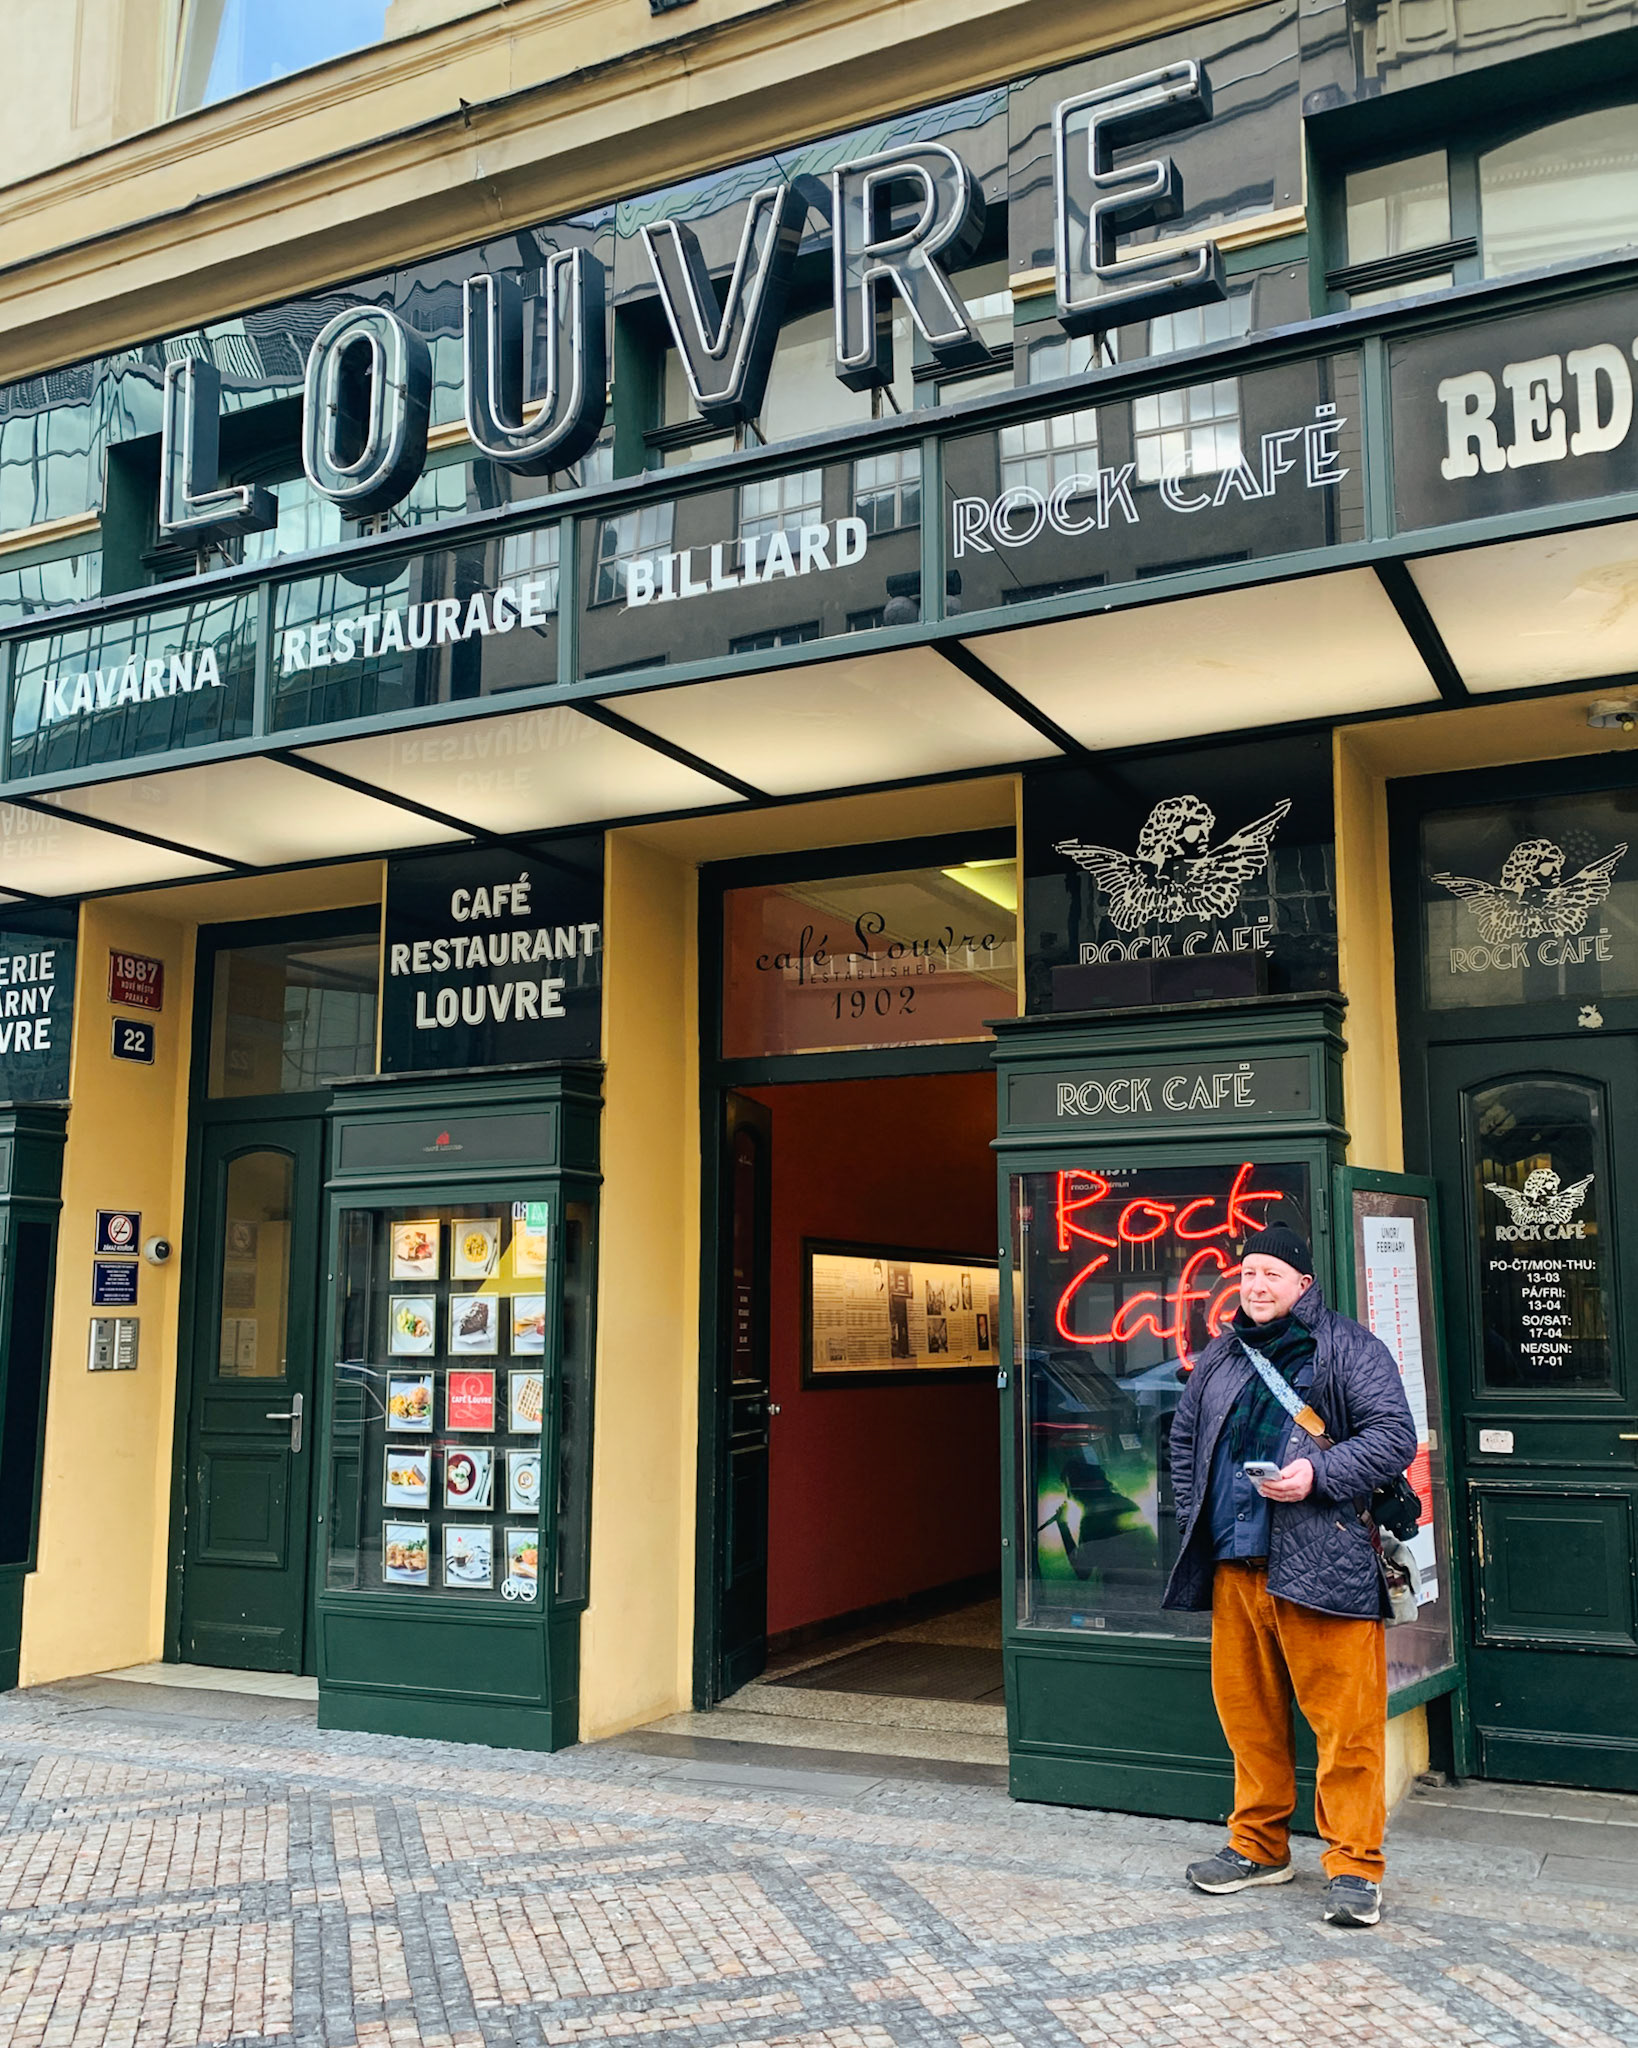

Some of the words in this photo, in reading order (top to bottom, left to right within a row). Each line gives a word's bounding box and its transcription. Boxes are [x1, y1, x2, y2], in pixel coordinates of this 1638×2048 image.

[158, 57, 1227, 541] LOUVRE
[1437, 336, 1638, 481] RED
[953, 462, 1139, 559] ROCK
[626, 516, 868, 608] BILLIARD
[282, 580, 550, 674] RESTAURACE
[43, 645, 223, 721] KAVÁRNA
[450, 871, 532, 922] CAFÉ
[390, 922, 600, 976] RESTAURANT
[756, 925, 832, 986] café
[846, 911, 1007, 963] Louvre
[1079, 934, 1172, 966] ROCK
[1449, 941, 1531, 974] ROCK
[116, 955, 158, 984] 1987
[810, 962, 937, 985] ESTABLISHED
[0, 985, 55, 1018] RNY
[415, 976, 567, 1029] LOUVRE
[831, 985, 918, 1020] 1902
[123, 1028, 146, 1053] 22
[1056, 1078, 1153, 1116] ROCK
[1055, 1162, 1285, 1252] Rock
[1495, 1224, 1541, 1242] ROCK
[1489, 1257, 1597, 1271] PO-ČT/MON-THU:
[1526, 1272, 1561, 1283] 13-03
[1521, 1285, 1567, 1298] PÁ/FRI:
[1527, 1300, 1562, 1311] 13-04
[1521, 1314, 1572, 1326] SO/SAT:
[1528, 1327, 1563, 1338] 17-04
[1520, 1342, 1573, 1354] NE/SUN:
[1529, 1355, 1563, 1366] 17-01
